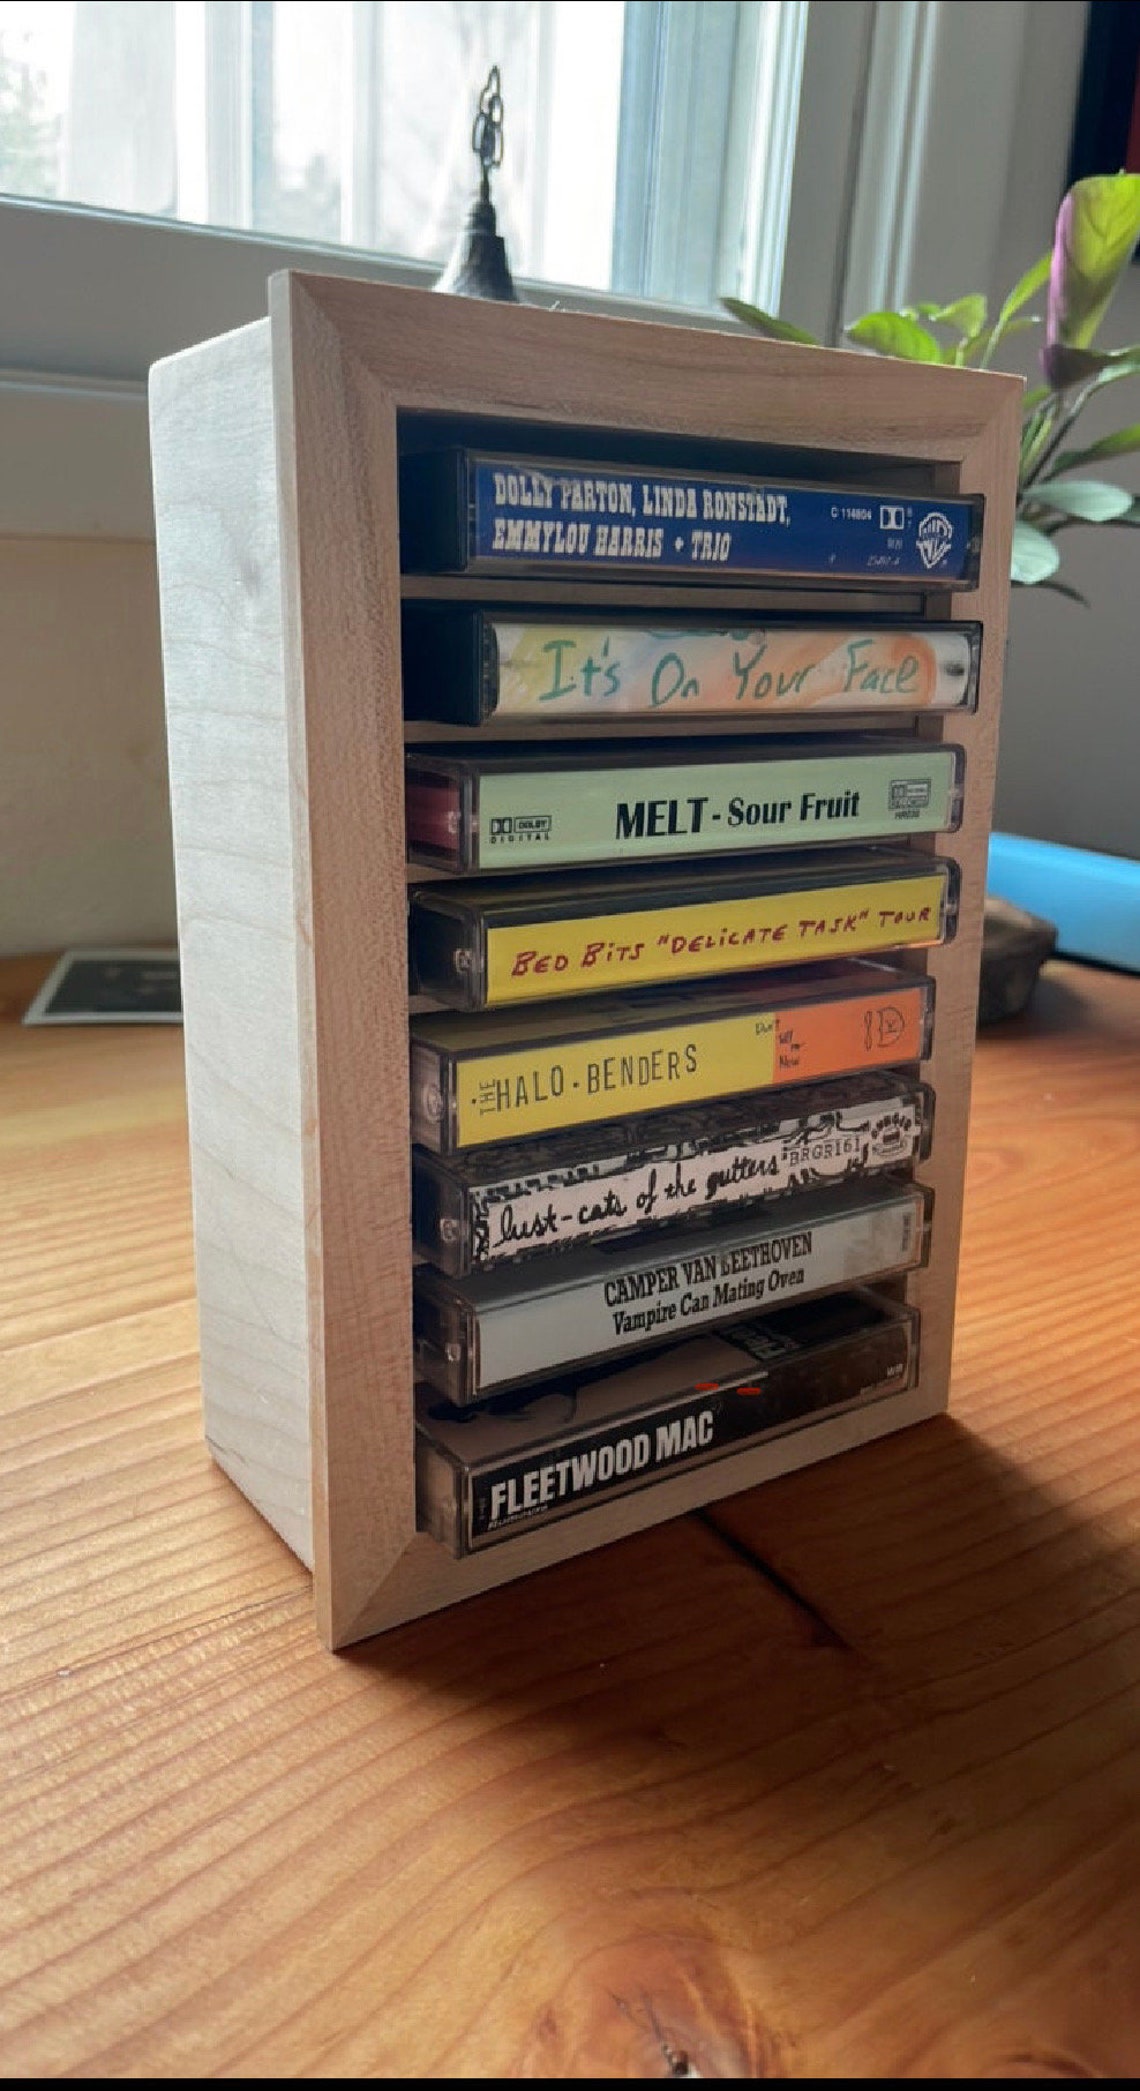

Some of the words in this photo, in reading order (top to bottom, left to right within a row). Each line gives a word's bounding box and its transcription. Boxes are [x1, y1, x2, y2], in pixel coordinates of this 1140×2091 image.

[494, 472, 552, 508] DOLLY
[560, 477, 636, 517] PARTON,
[643, 484, 698, 518] LINDA
[703, 489, 791, 528] RONSTADT,
[492, 517, 591, 553] EMMYLOU
[594, 523, 664, 558] HARRIS
[691, 529, 732, 561] TRIO
[539, 636, 621, 701] It's
[650, 652, 699, 708] On
[733, 644, 815, 700] Your
[844, 639, 919, 694] Face
[616, 797, 708, 839] MELT
[728, 797, 792, 827] Sour
[800, 789, 860, 821] Fruit
[511, 951, 569, 977] BED
[879, 907, 931, 928] TOUR
[479, 1078, 496, 1116] THE
[636, 1168, 657, 1214] of
[664, 1162, 697, 1197] the
[604, 1266, 680, 1307] CAMPER
[681, 1254, 716, 1285] VAN
[613, 1301, 677, 1335] Vampire
[680, 1292, 709, 1316] Can
[713, 1278, 765, 1307] Mating
[768, 1268, 804, 1292] Oven
[491, 1434, 650, 1520] FLEETWOOD
[656, 1410, 713, 1462] MAC
